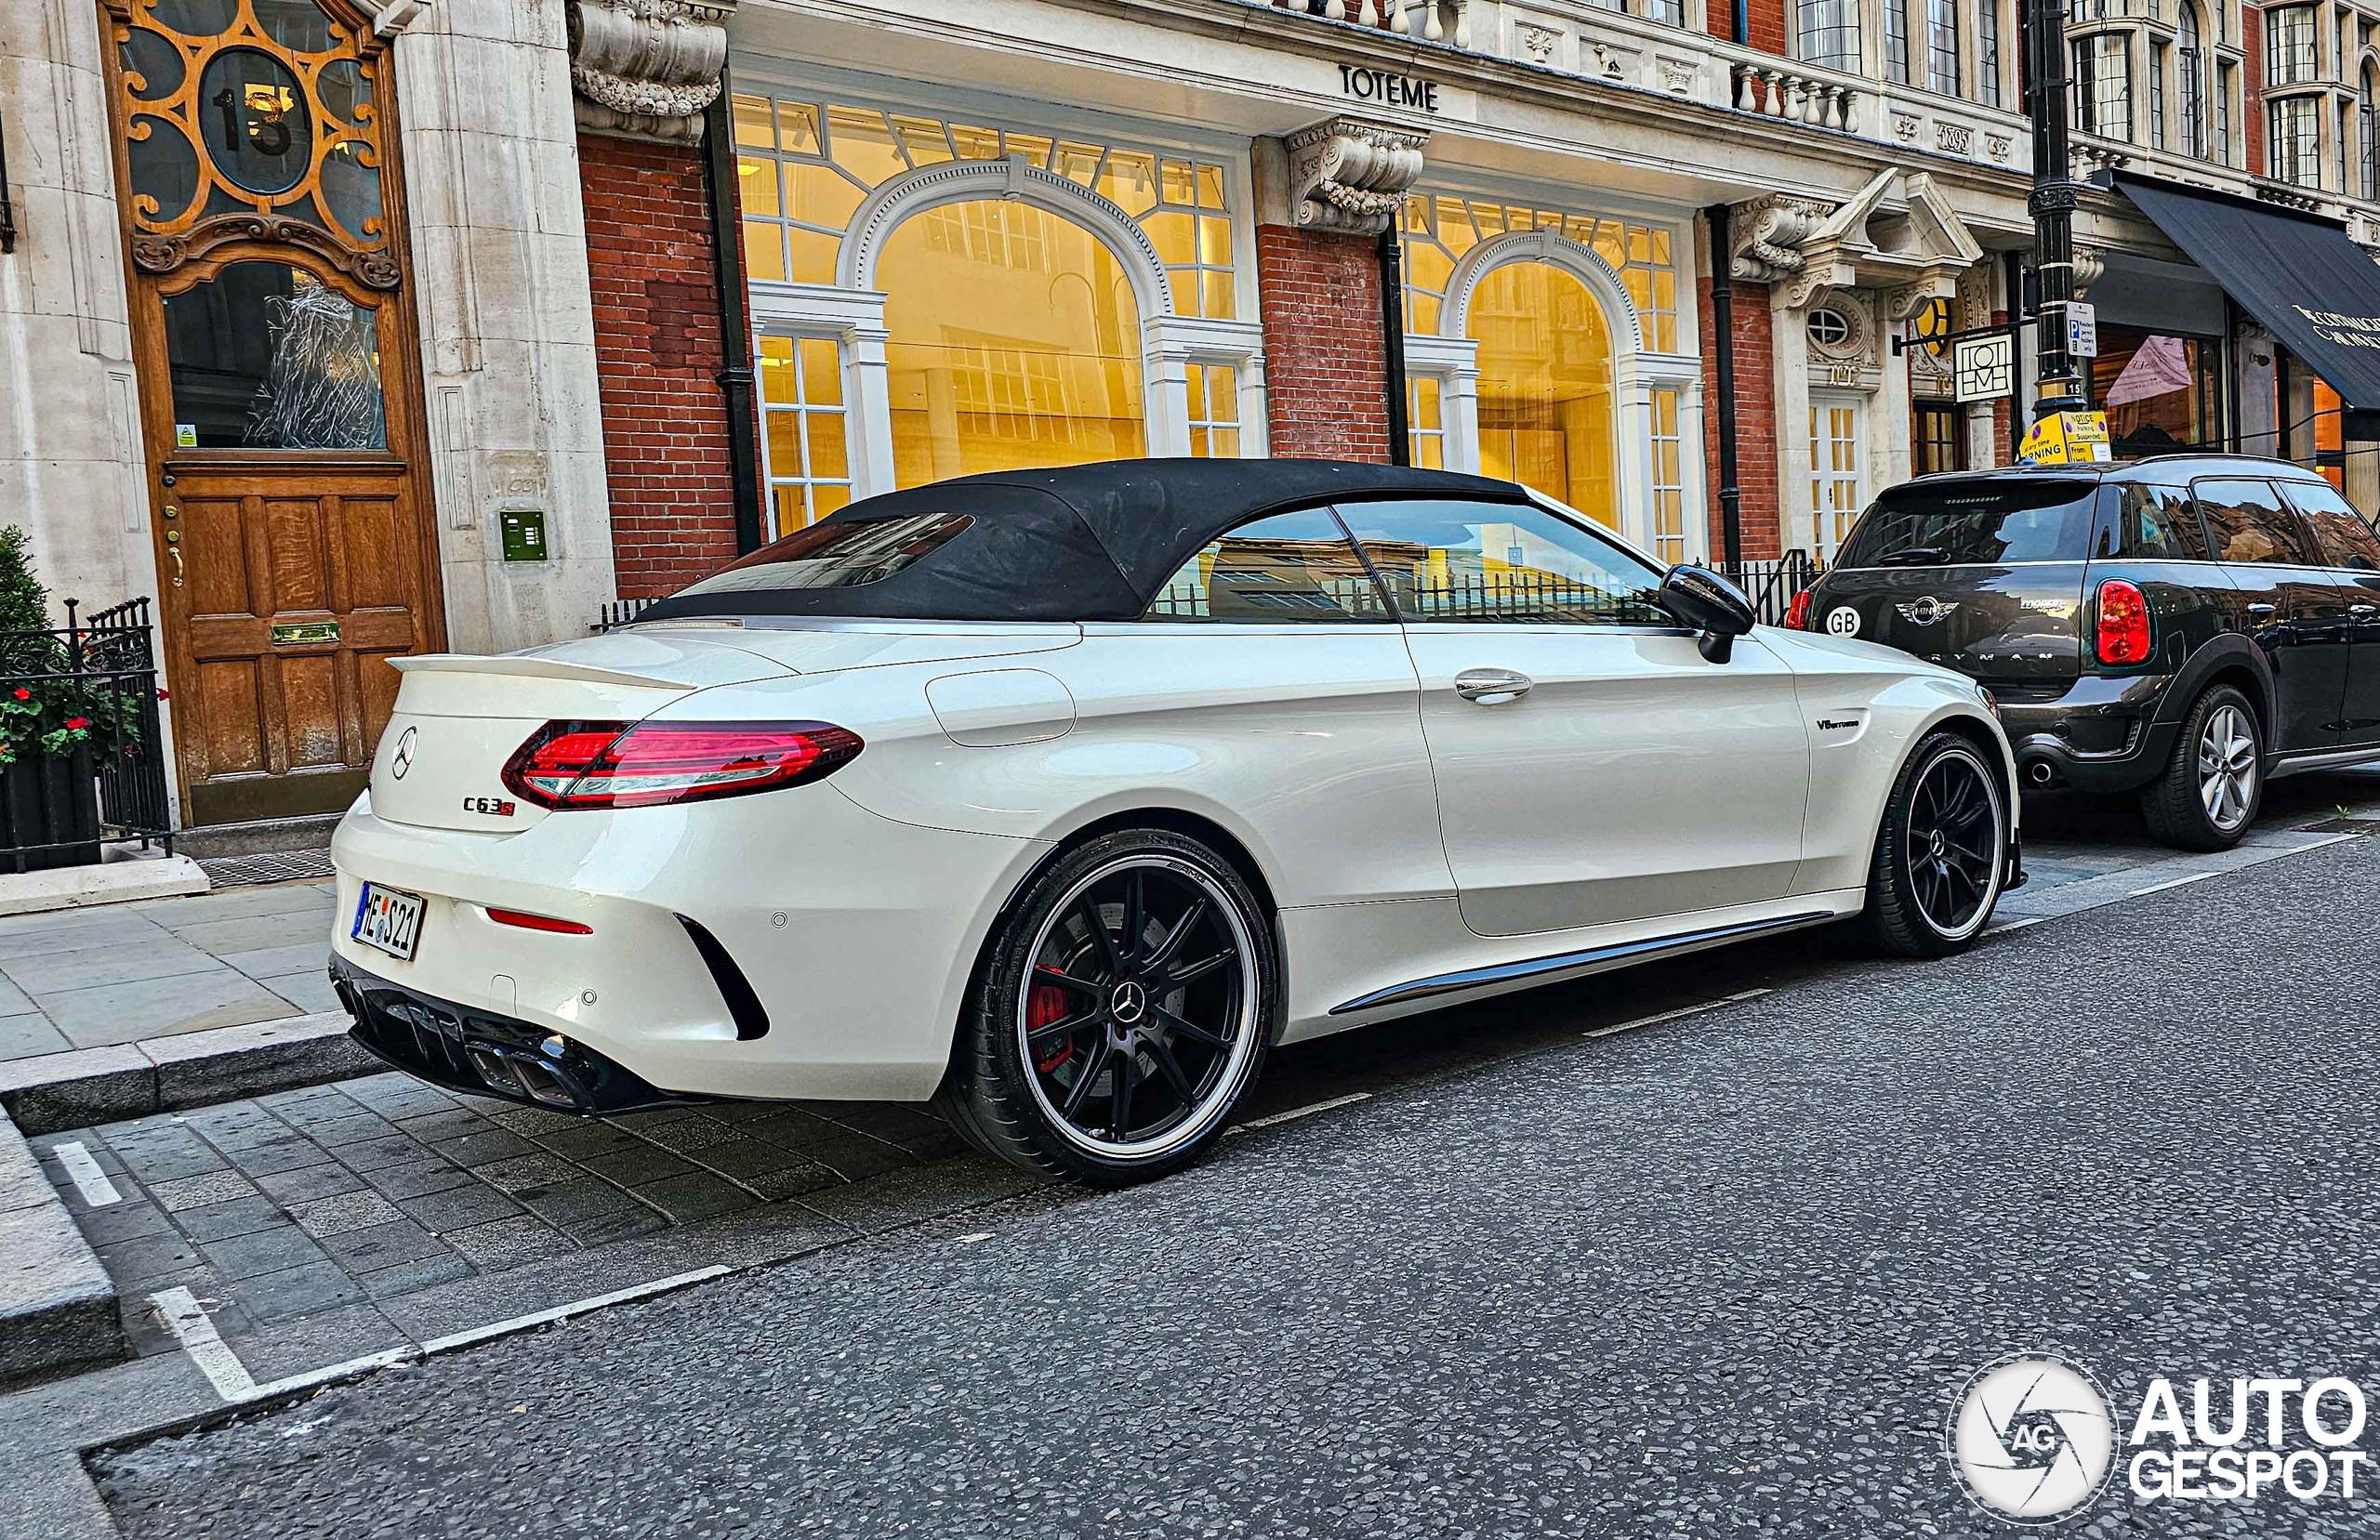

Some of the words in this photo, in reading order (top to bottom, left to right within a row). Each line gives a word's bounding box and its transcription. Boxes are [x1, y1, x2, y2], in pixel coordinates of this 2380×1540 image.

[1338, 64, 1438, 111] TOTEME
[213, 88, 292, 156] 13
[2069, 383, 2081, 394] 15
[2071, 414, 2095, 423] NOTICE
[2076, 432, 2101, 441] Suspended
[2038, 439, 2050, 447] time
[2025, 443, 2061, 461] RNING
[1915, 607, 1937, 615] MINI
[1831, 612, 1855, 634] GB
[1916, 652, 2053, 662] RYMAN
